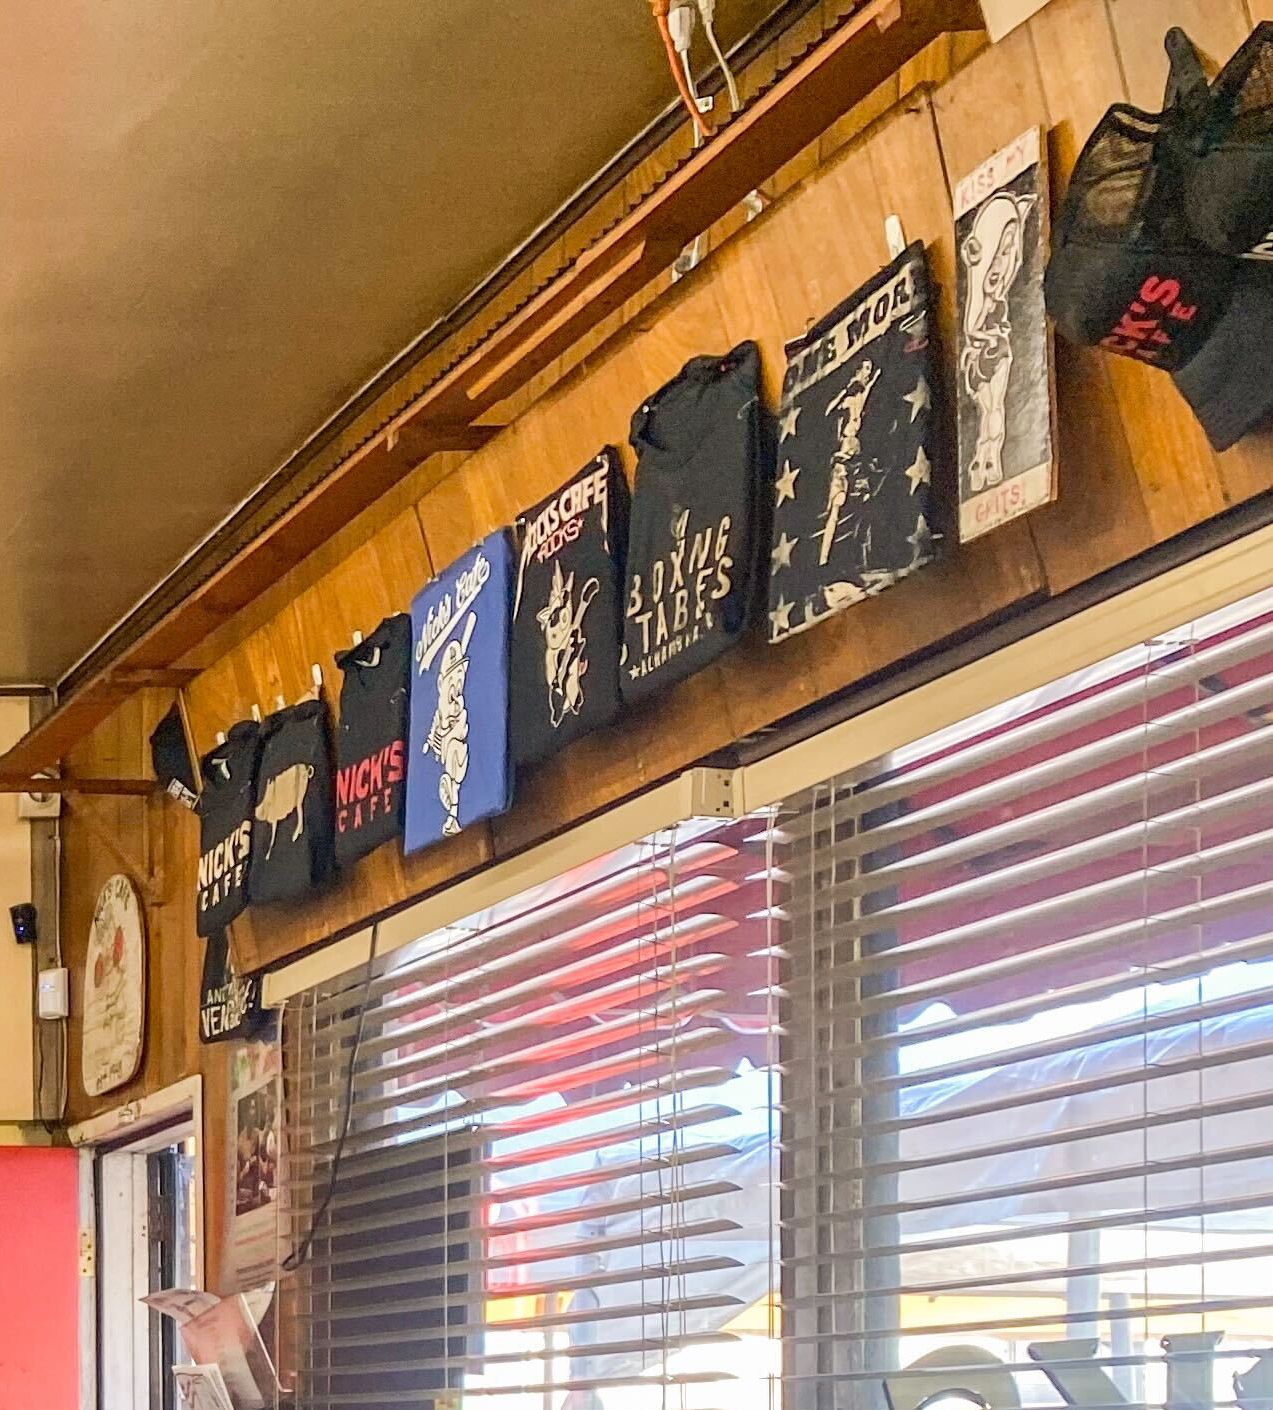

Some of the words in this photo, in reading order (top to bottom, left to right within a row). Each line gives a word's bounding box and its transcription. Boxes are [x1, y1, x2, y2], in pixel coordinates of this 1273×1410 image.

[335, 738, 406, 806] NICK'S
[338, 795, 393, 833] CAFE
[197, 819, 252, 891] NICK'S
[200, 865, 244, 912] CAFE
